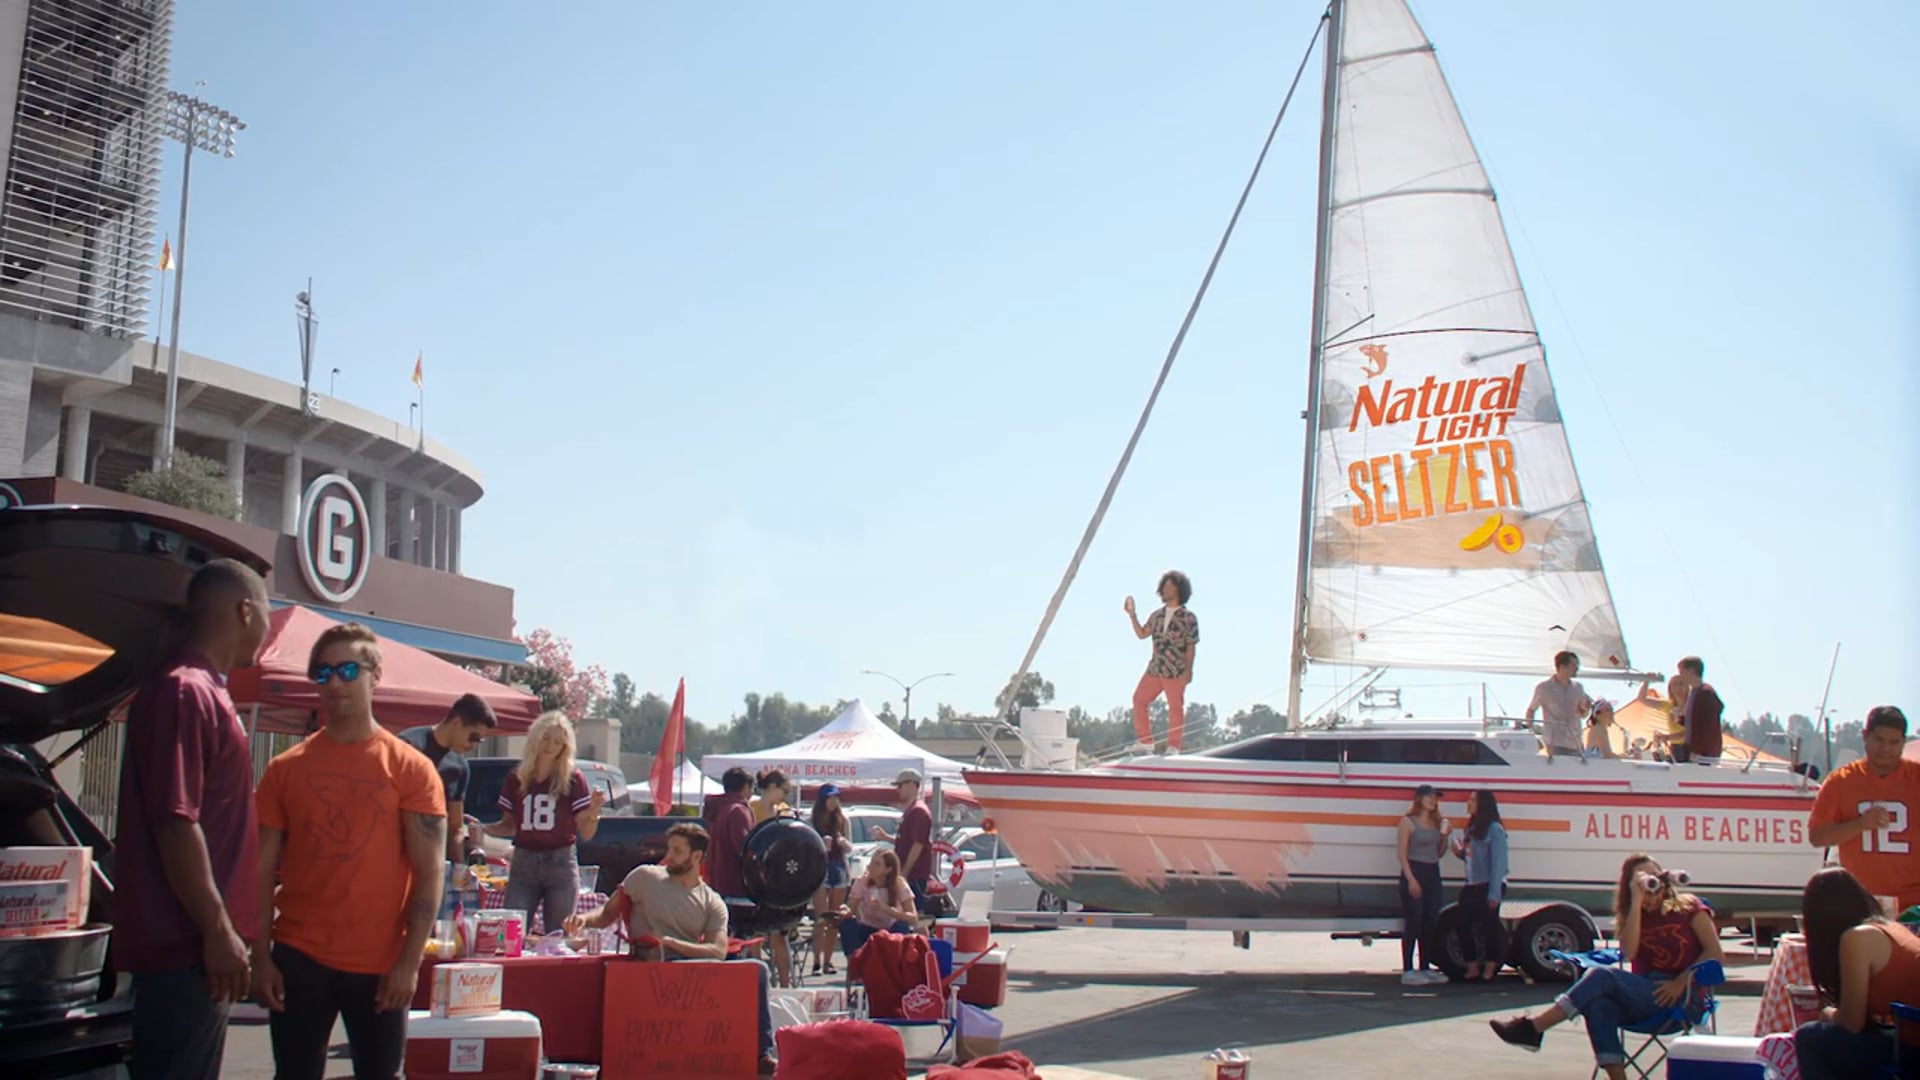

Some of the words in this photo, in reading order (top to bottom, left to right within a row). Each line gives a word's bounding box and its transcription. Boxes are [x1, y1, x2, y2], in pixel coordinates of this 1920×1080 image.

[1348, 363, 1527, 432] Natural
[1415, 411, 1516, 446] LIGHT
[1347, 439, 1522, 528] SELTZER
[318, 496, 355, 580] G
[804, 764, 857, 776] BEACHES
[520, 793, 557, 831] 18
[1584, 813, 1670, 841] ALOHA
[1684, 815, 1803, 844] BEACHES
[0, 860, 68, 880] atural
[0, 893, 37, 908] atural
[457, 972, 498, 987] Natural
